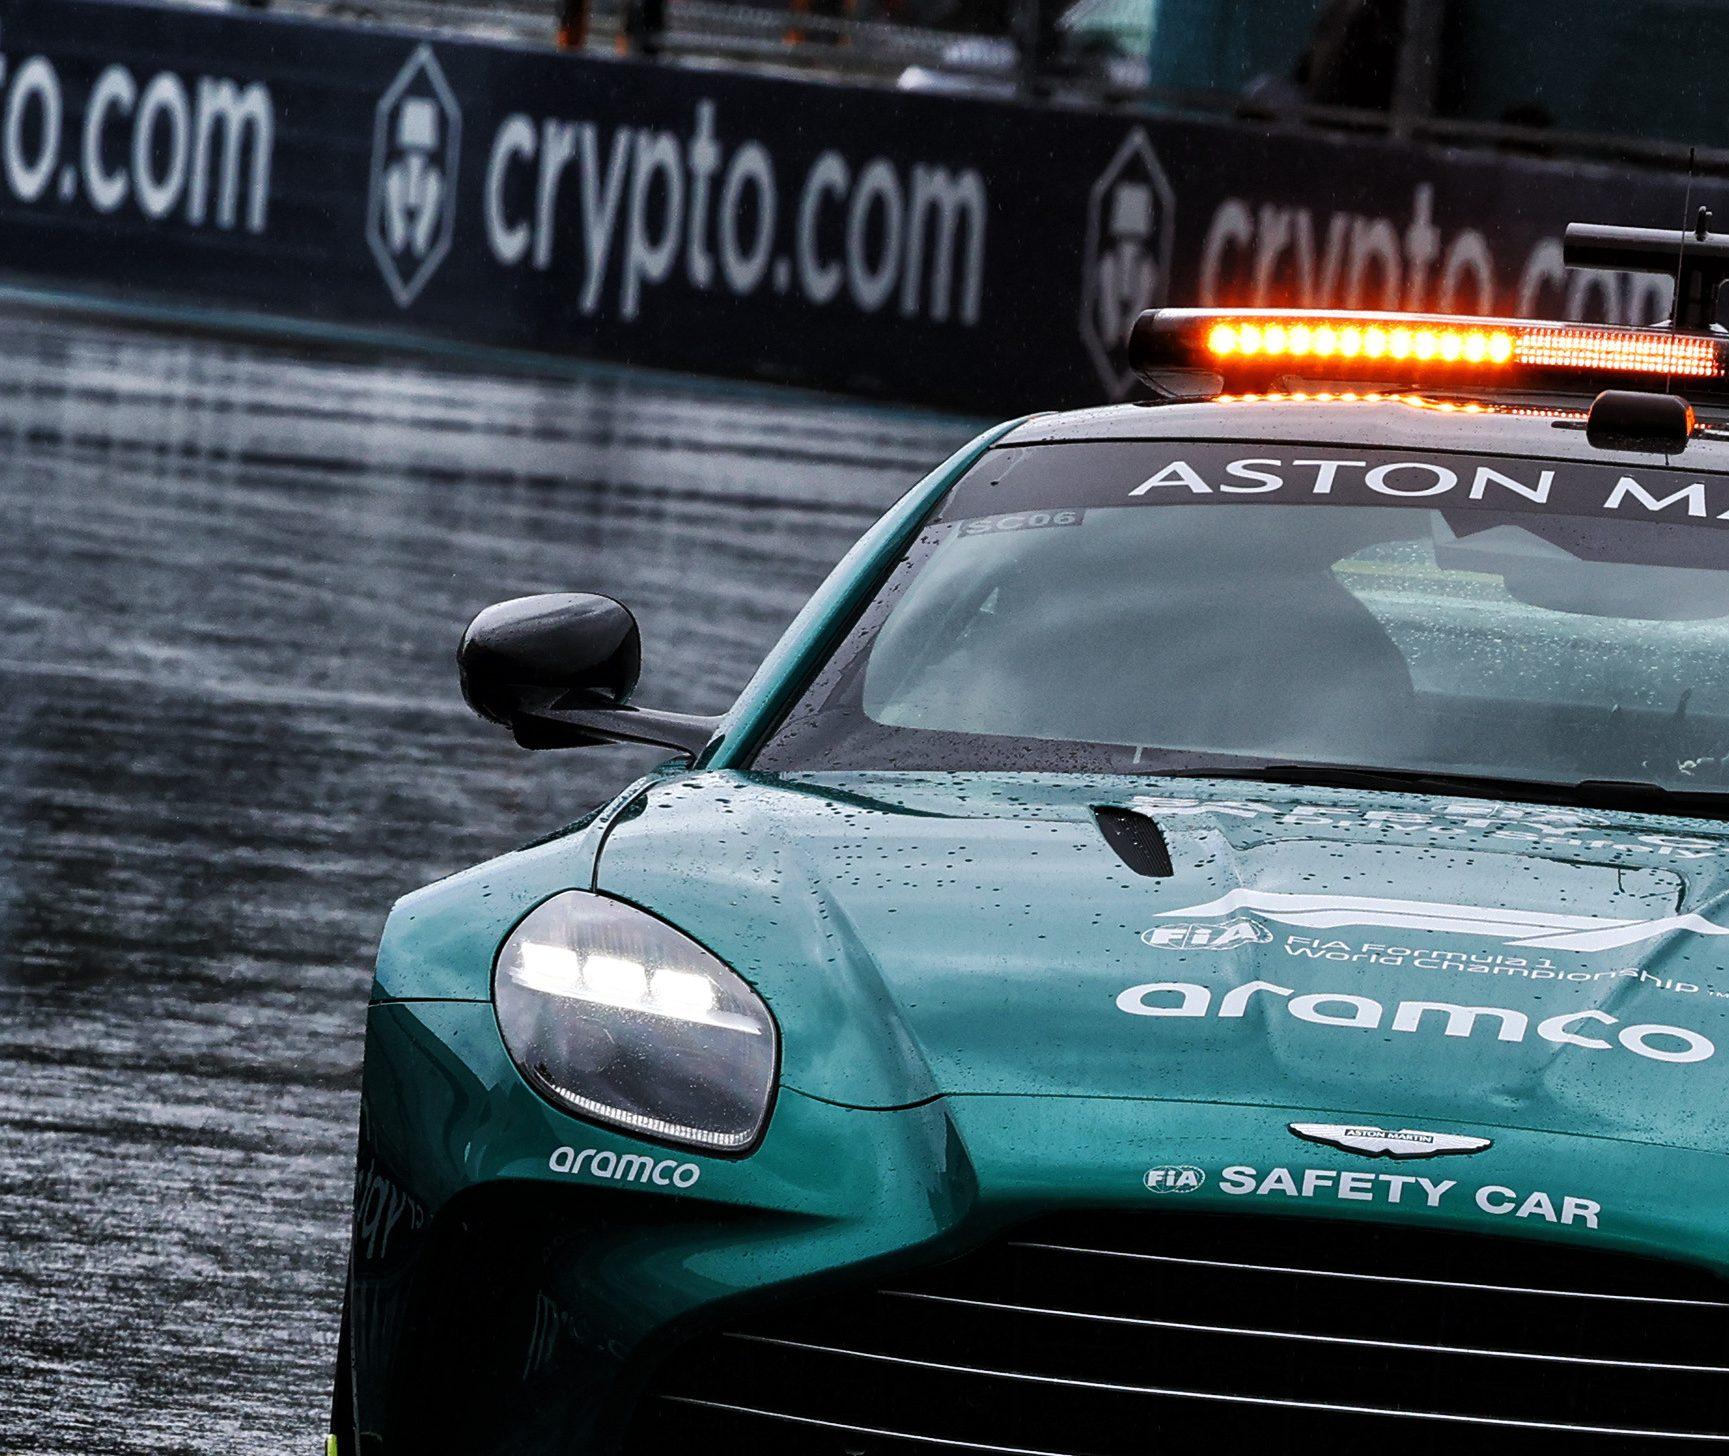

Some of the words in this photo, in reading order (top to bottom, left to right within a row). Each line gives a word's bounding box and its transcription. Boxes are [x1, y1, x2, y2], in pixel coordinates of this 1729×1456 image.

[484, 100, 986, 322] crypto.com
[1128, 459, 1556, 505] ASTON
[965, 511, 1076, 534] SC06
[1283, 944, 1404, 967] World
[1413, 957, 1700, 994] Championship
[1286, 935, 1351, 951] FIA
[1361, 943, 1527, 967] Formula
[1532, 957, 1557, 970] 1
[1116, 981, 1716, 1064] aramco
[1346, 1129, 1386, 1139] ASTON
[1387, 1132, 1432, 1144] MARTIN
[548, 1146, 701, 1189] aramco
[1218, 1165, 1458, 1208] SAFETY
[1475, 1185, 1602, 1230] CAR
